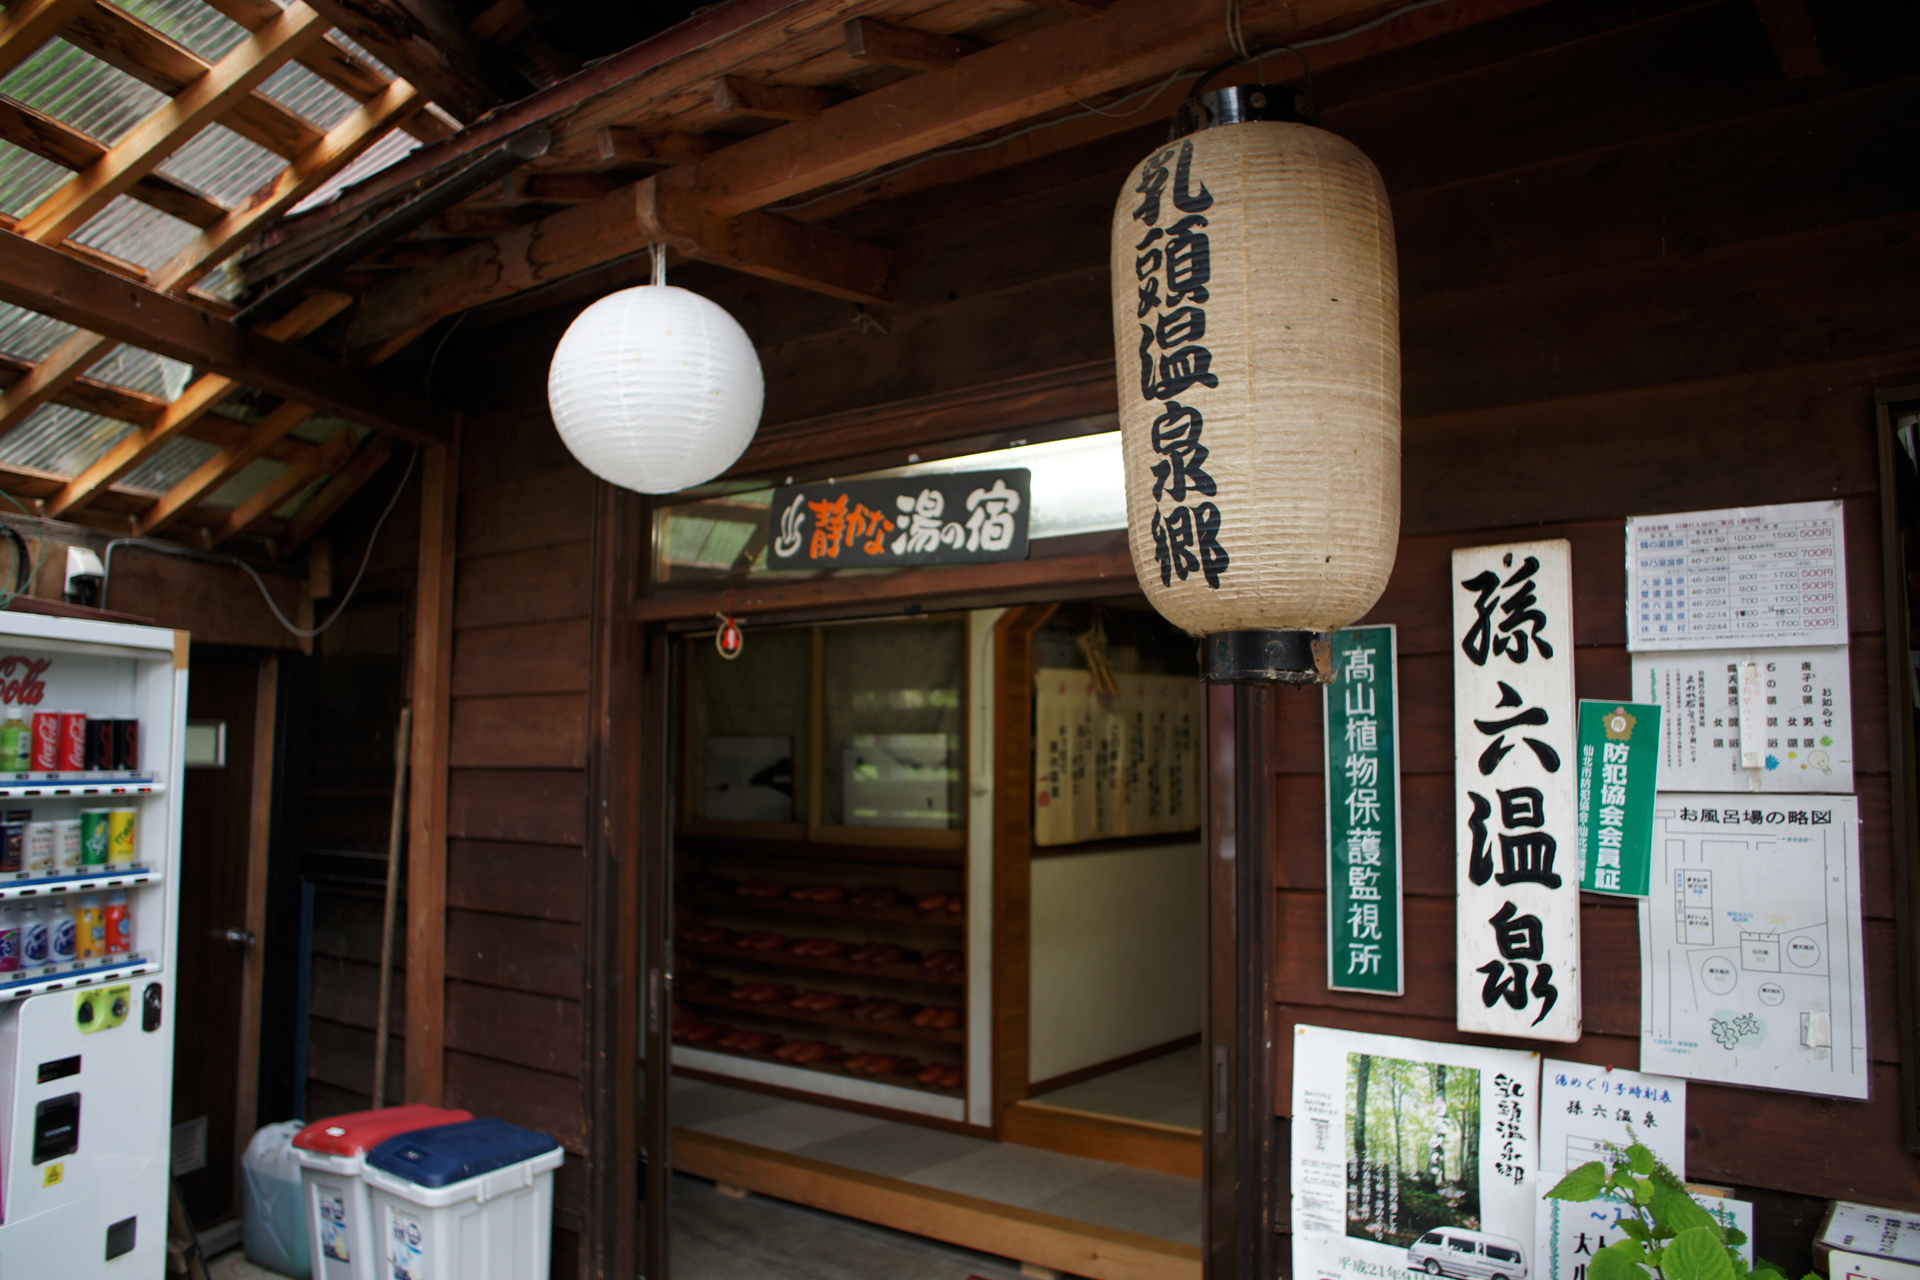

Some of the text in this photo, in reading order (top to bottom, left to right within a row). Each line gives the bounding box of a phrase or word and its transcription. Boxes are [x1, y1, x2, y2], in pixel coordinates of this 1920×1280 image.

[1132, 137, 1230, 590] 乳頭温泉郷
[808, 479, 1020, 560] 静かな湯の宿
[1799, 528, 1832, 538] 500円
[1800, 548, 1833, 557] 700円
[1801, 568, 1834, 578] 500円
[1802, 581, 1834, 590] 500円
[1802, 593, 1834, 602] 500円
[1802, 606, 1835, 615] 500円
[1803, 618, 1835, 627] 500円
[1460, 556, 1562, 1027] 孫六温泉
[1594, 742, 1630, 890] 防犯協会会員証
[1680, 807, 1832, 825] お風呂場の略図
[1567, 1099, 1658, 1129] 孫六温泉
